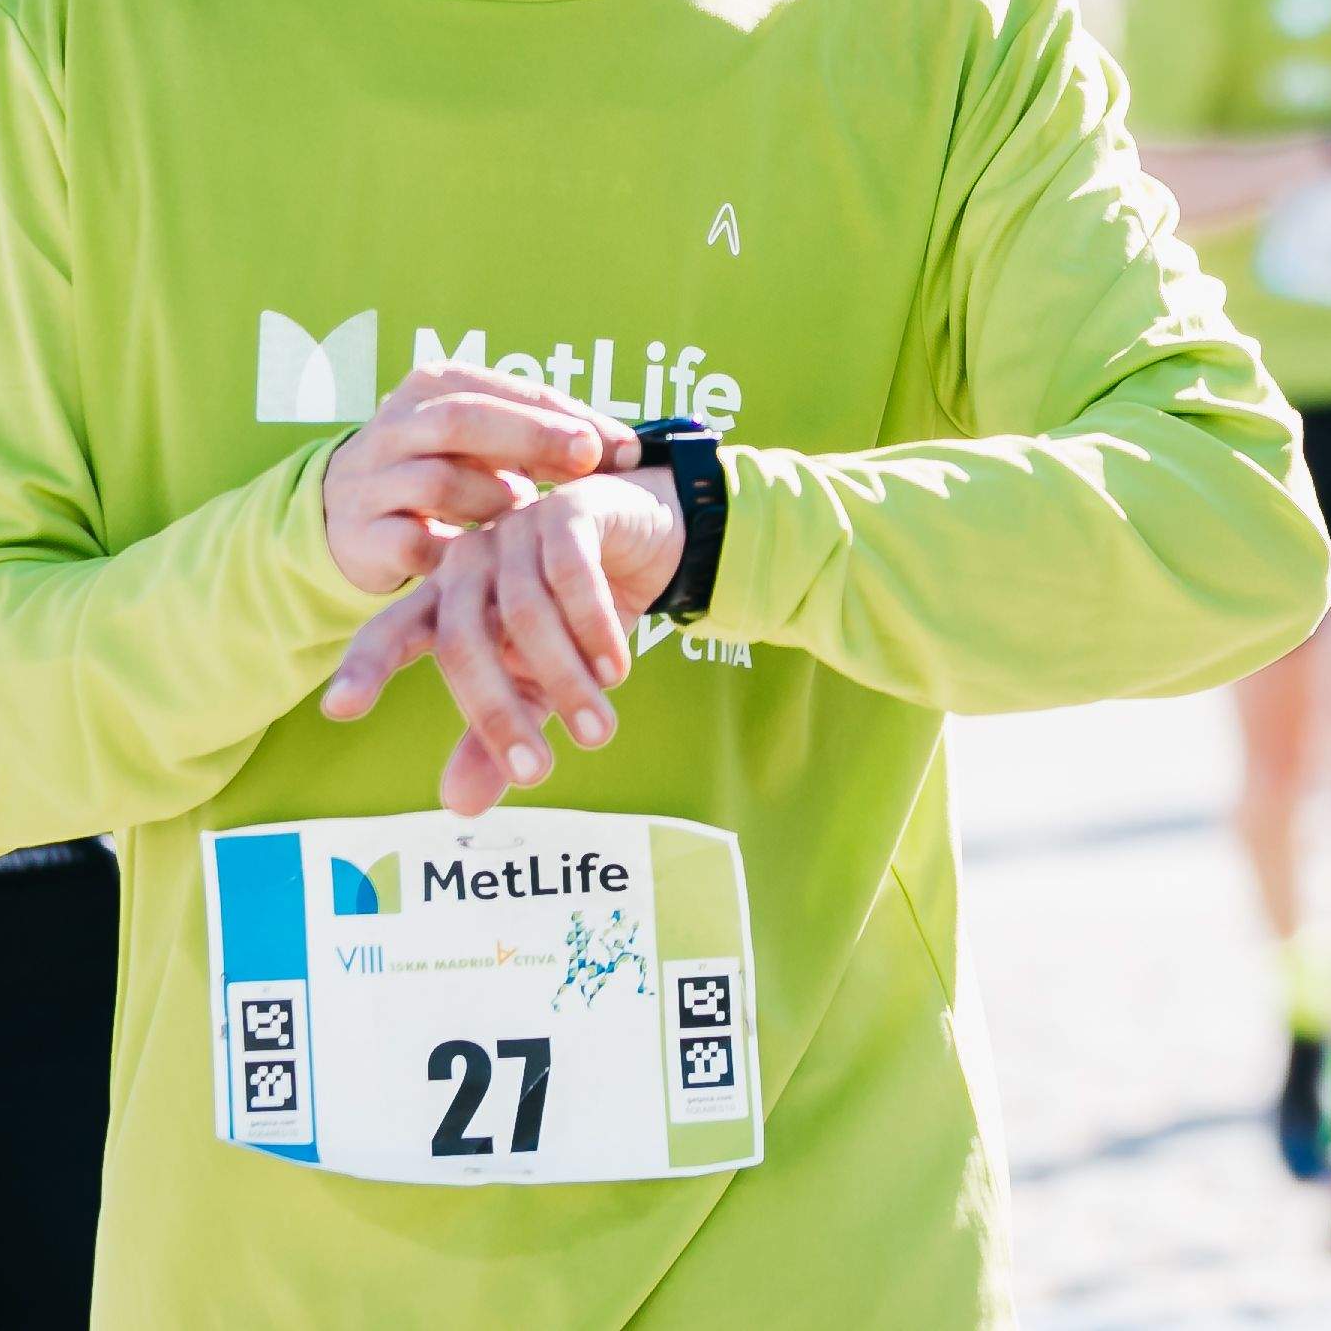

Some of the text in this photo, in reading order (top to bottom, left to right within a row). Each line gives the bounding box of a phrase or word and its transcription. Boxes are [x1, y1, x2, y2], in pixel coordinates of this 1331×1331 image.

[423, 851, 630, 902] MetLife
[335, 944, 384, 974] VIII
[434, 955, 495, 971] MADRID
[426, 1036, 552, 1158] 27
